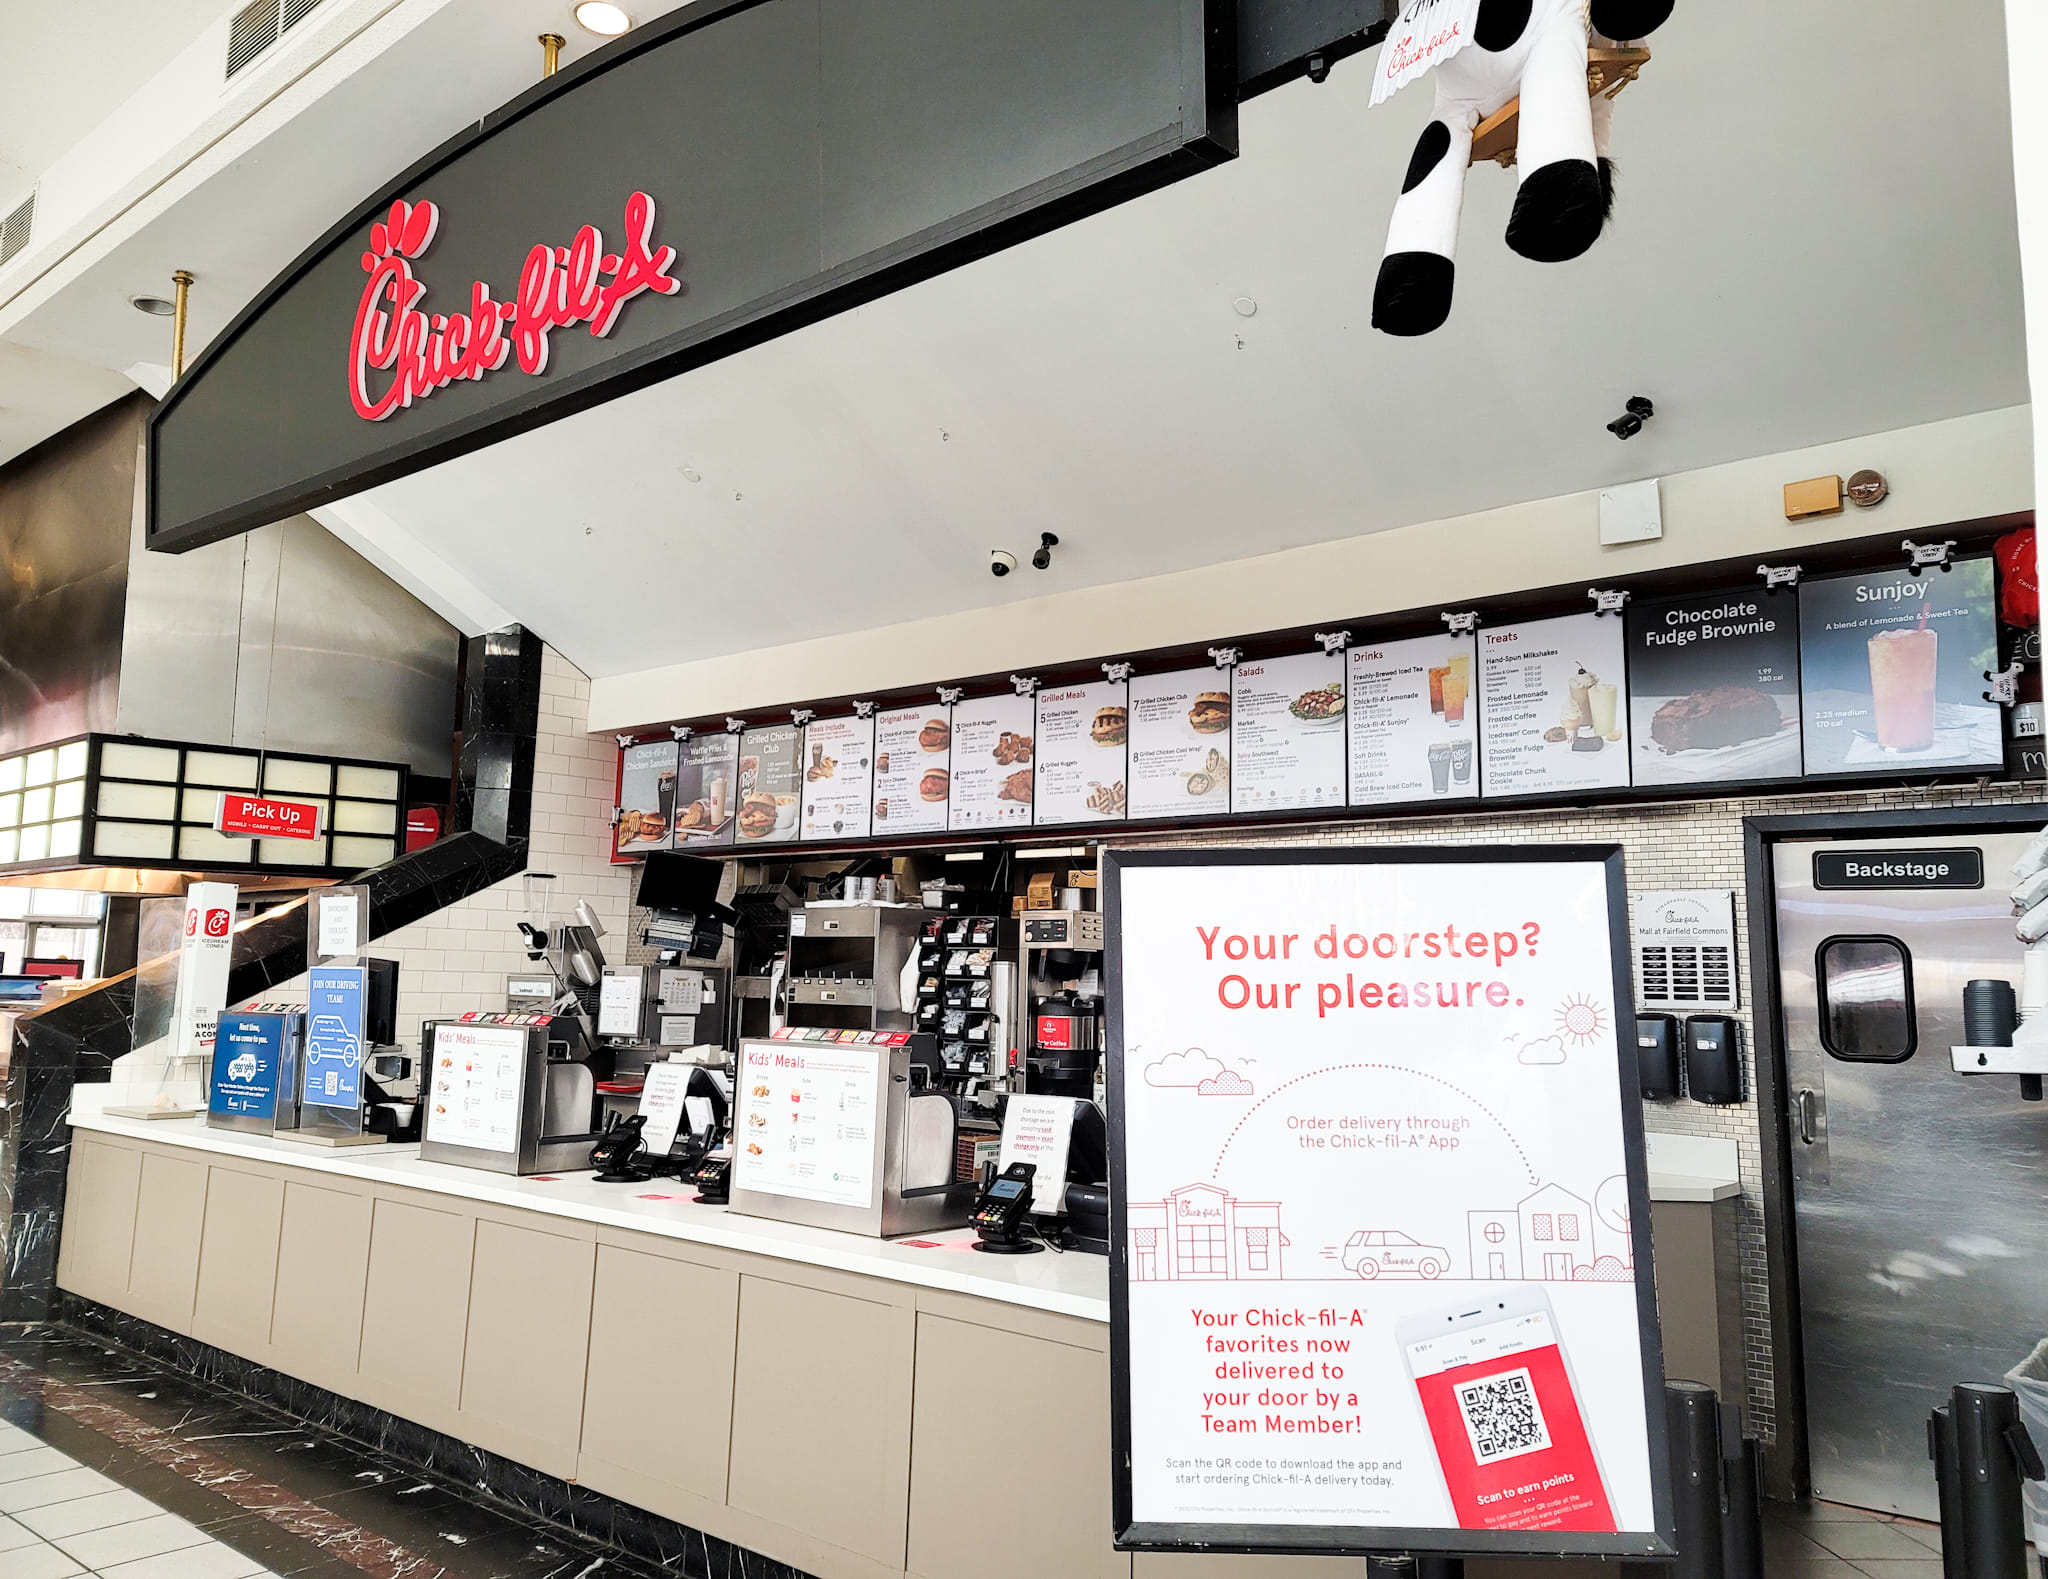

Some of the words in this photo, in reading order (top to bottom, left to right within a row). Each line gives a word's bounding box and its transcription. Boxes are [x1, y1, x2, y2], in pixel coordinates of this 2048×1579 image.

[348, 191, 681, 422] Chick-fil-A
[1665, 602, 1758, 626] Chocolate
[1825, 622, 1833, 631] A
[1833, 620, 1857, 631] blend
[1859, 618, 1868, 627] of
[1869, 613, 1914, 626] Lemonade
[1916, 612, 1923, 620] &
[1924, 609, 1952, 620] Sweet
[1952, 607, 1969, 617] Tea
[1485, 632, 1518, 645] Treats
[1646, 629, 1697, 647] Fudge
[1701, 618, 1776, 640] Brownie
[1354, 650, 1384, 662] Drinks
[1486, 655, 1522, 665] Hand-Spun
[1523, 649, 1558, 660] Milkshakes
[1238, 666, 1265, 677] Salads
[1354, 669, 1398, 681] Freshly-Brewed
[1398, 667, 1412, 675] Iced
[1758, 667, 1772, 675] 1.99
[1773, 674, 1784, 682] cal
[1041, 692, 1065, 703] Grilled
[1066, 689, 1086, 700] Meals
[1488, 693, 1512, 703] Frosted
[1513, 689, 1548, 700] Lemonade
[1133, 699, 1140, 711] 7
[879, 714, 902, 725] Original
[903, 712, 920, 721] Meals
[1040, 713, 1046, 724] 5
[1488, 715, 1512, 724] Frosted
[1514, 712, 1537, 721] Coffee
[1834, 708, 1868, 719] medium
[825, 723, 845, 731] Include
[1237, 719, 1256, 727] Market
[1816, 720, 1830, 728] 170
[1831, 719, 1843, 728] cal
[2020, 722, 2035, 733] $10
[747, 732, 770, 745] Grilled
[769, 730, 798, 742] Chicken
[689, 746, 708, 756] Waffle
[708, 744, 722, 753] Fries
[763, 743, 780, 754] Club
[1489, 746, 1522, 755] Chocolate
[1523, 744, 1544, 752] Fudge
[625, 761, 648, 771] Chicken
[648, 758, 676, 769] Sandwich
[683, 757, 704, 766] Frosted
[705, 754, 734, 764] Lemonade
[1489, 754, 1516, 762] Brownie
[1040, 762, 1046, 774] 6
[1489, 769, 1523, 778] Chocolate
[1524, 767, 1547, 775] Chunk
[1354, 785, 1369, 793] Cold
[1400, 781, 1422, 789] Coffee
[242, 802, 275, 819] Pick
[280, 807, 300, 824] Up
[286, 827, 312, 835] CATERING
[1845, 861, 1949, 879] Backstage
[1662, 927, 1691, 935] Fairfield
[1196, 926, 1299, 960] Your
[1314, 921, 1541, 967] doorstep?
[313, 980, 324, 990] JOIN
[325, 980, 336, 989] OUR
[337, 980, 359, 990] DRIVING
[327, 994, 344, 1004] TEAM!
[1218, 975, 1301, 1009] Our
[1317, 973, 1525, 1018] pleasure.
[438, 1031, 455, 1043] Kids'
[456, 1032, 476, 1045] Meals
[748, 1051, 773, 1066] Kids'
[775, 1054, 805, 1069] Meals
[1287, 1115, 1333, 1129] Order
[1339, 1115, 1401, 1132] delivery
[1407, 1115, 1470, 1132] through
[1191, 1308, 1238, 1327] Your
[1206, 1334, 1299, 1353] favorites
[1307, 1339, 1350, 1353] now
[1470, 1336, 1486, 1346] Scan
[1215, 1361, 1314, 1379] delivered
[1321, 1362, 1344, 1379] to
[1203, 1392, 1250, 1410] your
[1258, 1388, 1308, 1406] door
[1316, 1388, 1340, 1411] by
[1347, 1393, 1358, 1406] a
[1201, 1414, 1257, 1432] Team
[1265, 1415, 1361, 1433] Member!
[1166, 1458, 1191, 1469] Scan
[1194, 1457, 1212, 1469] the
[1216, 1458, 1232, 1469] QR
[1235, 1458, 1262, 1469] code
[1265, 1459, 1277, 1469] to
[1280, 1458, 1333, 1470] download
[1337, 1459, 1354, 1470] the
[1358, 1461, 1378, 1473] app
[1382, 1459, 1402, 1470] and
[1175, 1474, 1200, 1484] start
[1203, 1473, 1249, 1486] ordering
[1252, 1473, 1312, 1485] Chick-fil-A
[1314, 1474, 1358, 1487] delivery
[1361, 1475, 1395, 1488] today.
[1477, 1493, 1502, 1506] Scan
[1503, 1488, 1515, 1498] to
[1517, 1483, 1541, 1495] earn
[1542, 1472, 1575, 1491] points
[1484, 1516, 1496, 1524] You
[1509, 1510, 1522, 1518] scan
[1523, 1507, 1535, 1515] your
[1536, 1502, 1546, 1510] QR
[1547, 1499, 1562, 1508] code
[1569, 1494, 1580, 1502] the
[1508, 1520, 1519, 1529] pay
[1539, 1511, 1552, 1519] earn
[1553, 1506, 1572, 1516] points
[1573, 1500, 1594, 1511] toward
